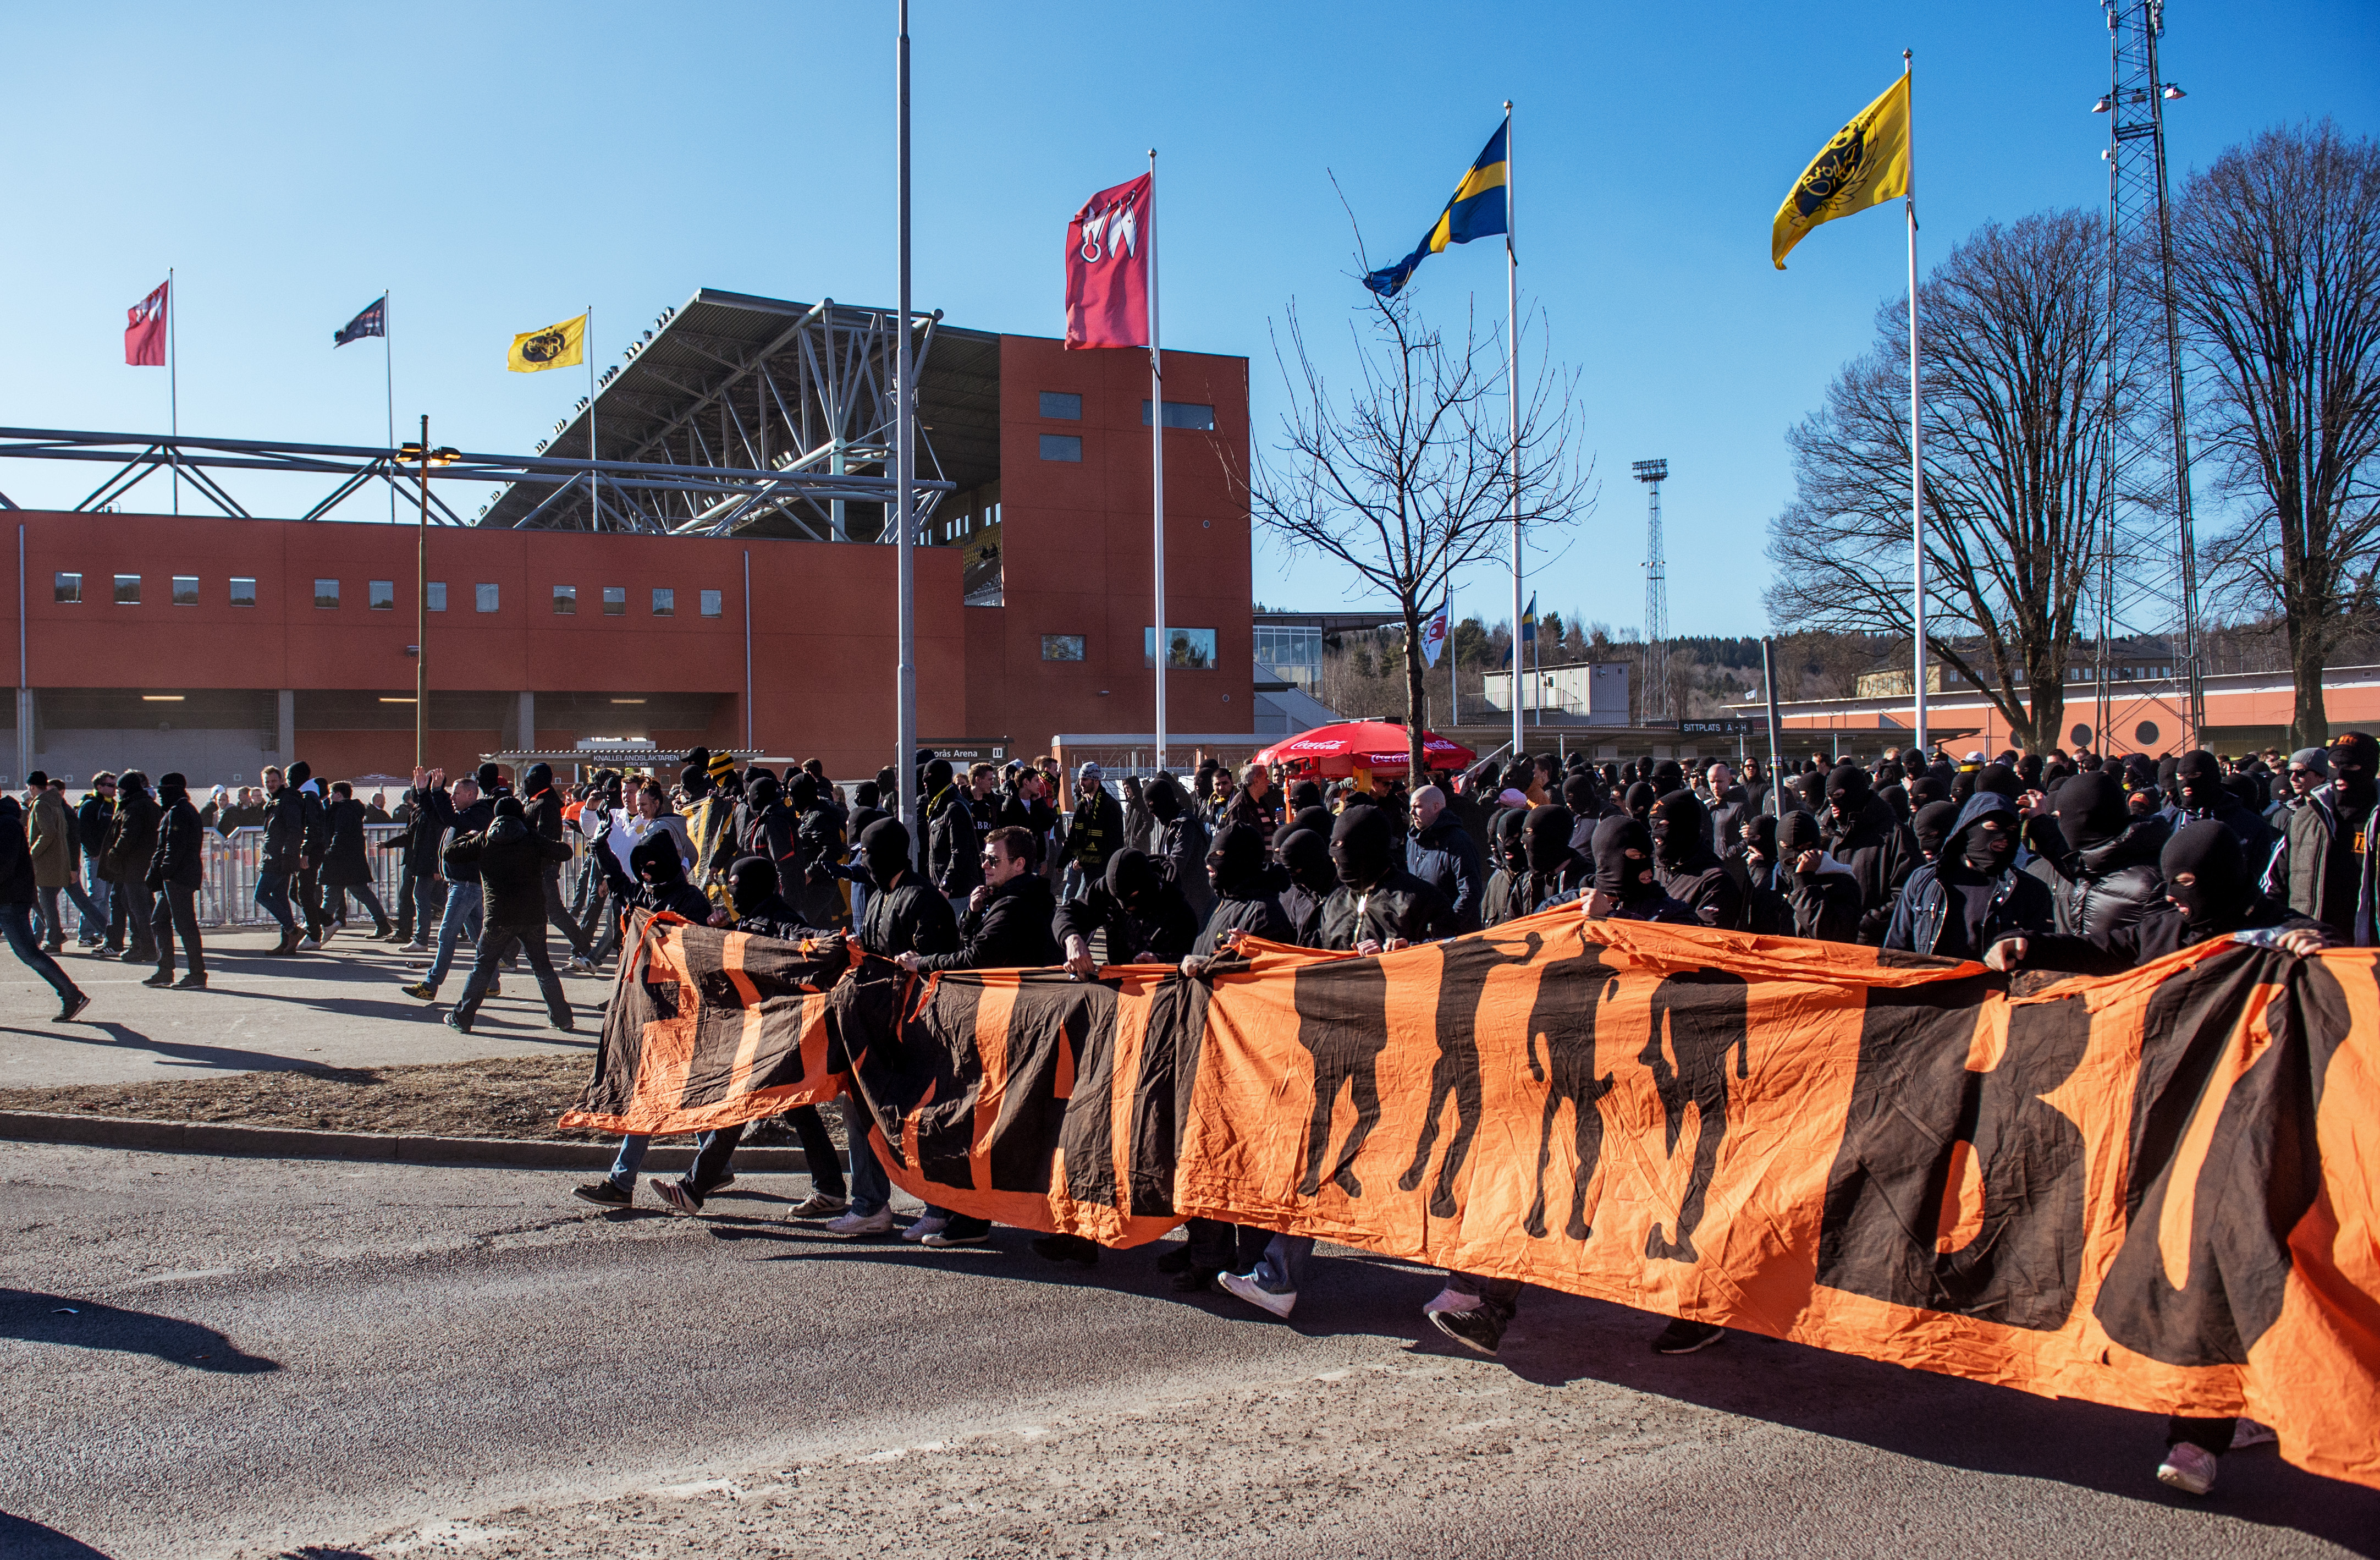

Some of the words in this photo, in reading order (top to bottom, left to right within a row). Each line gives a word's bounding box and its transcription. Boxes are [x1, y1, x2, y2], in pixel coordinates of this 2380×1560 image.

[1684, 723, 1721, 732] SITTPLATS
[935, 749, 951, 757] orås
[1816, 945, 2380, 1366] BO
